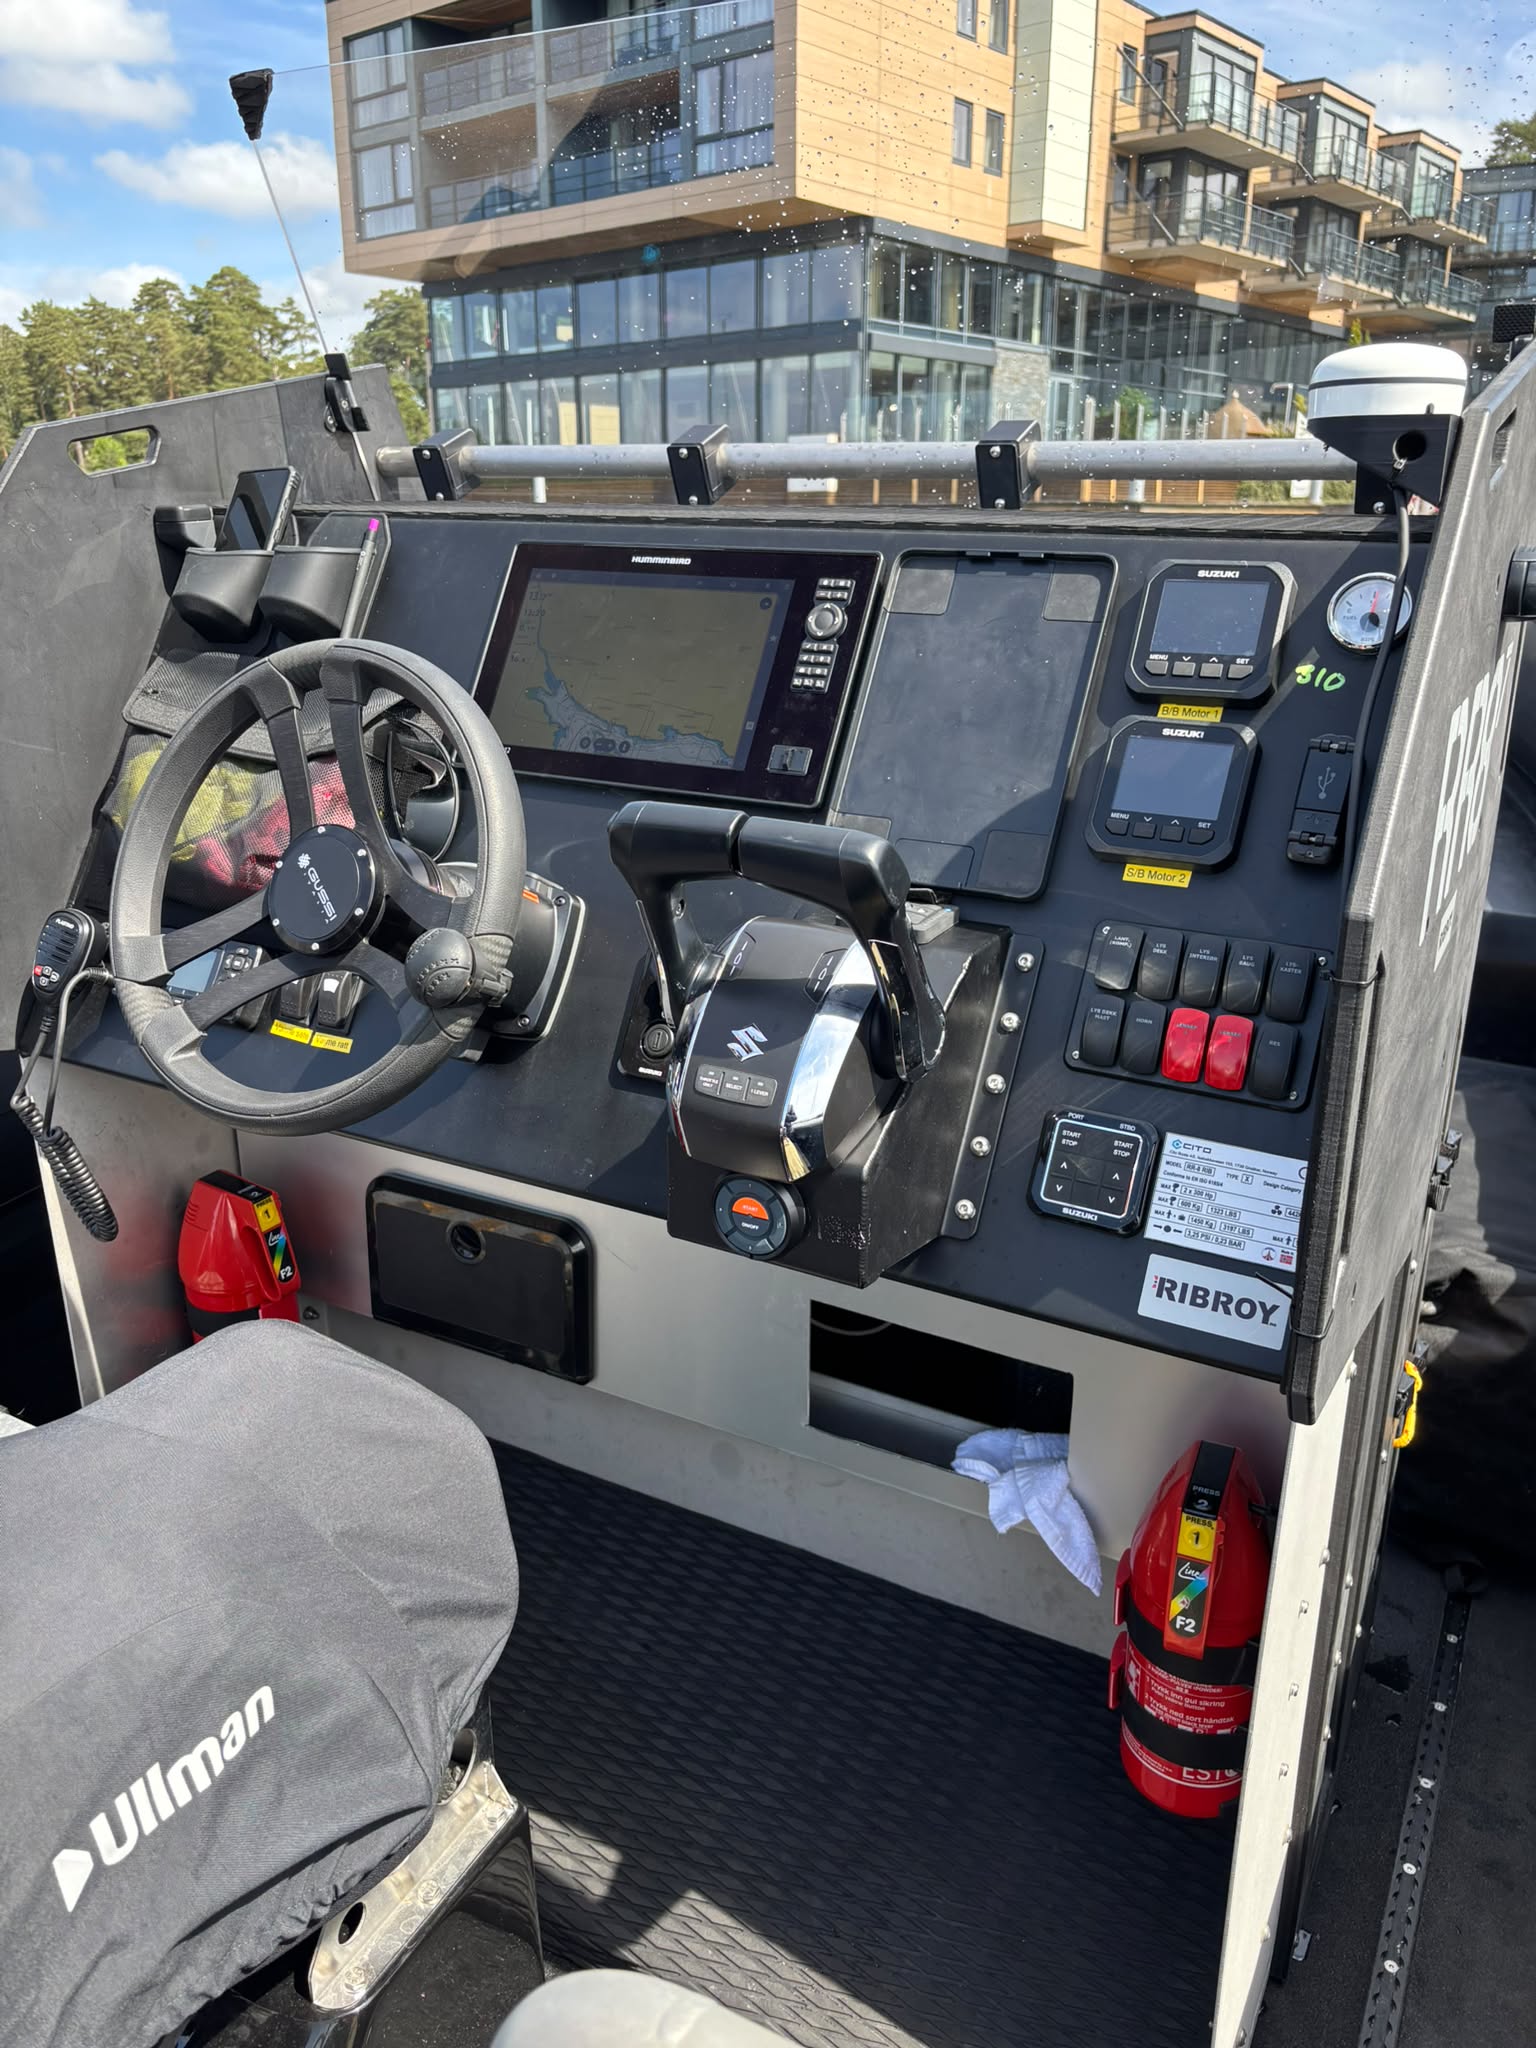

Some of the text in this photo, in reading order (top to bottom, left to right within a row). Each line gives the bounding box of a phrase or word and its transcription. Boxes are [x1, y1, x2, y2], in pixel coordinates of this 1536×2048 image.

[631, 555, 691, 565] HUMMINBIRD
[1197, 570, 1240, 578] SUZUKI
[1162, 706, 1219, 718] B/B Motor 1
[1162, 728, 1204, 739] SUZUKI
[1110, 812, 1130, 820] MENU
[1126, 867, 1186, 883] S/B Motor 2
[307, 867, 337, 921] GUSSI
[725, 1083, 743, 1091] SELECT
[754, 1089, 769, 1097] LEVER
[1068, 1112, 1085, 1120] PORT
[1062, 1130, 1082, 1138] START
[1113, 1140, 1134, 1149] START
[1183, 1144, 1212, 1154] CITO
[1113, 1149, 1131, 1157] STOP
[1165, 1160, 1183, 1169] MODEL
[1226, 1172, 1239, 1181] TYPE
[1160, 1182, 1171, 1190] MAX
[1205, 1192, 1214, 1201] Hp
[1263, 1180, 1302, 1195] Design Category
[1157, 1195, 1169, 1203] MAX
[1192, 1203, 1201, 1212] Kg
[263, 1209, 271, 1219] 1
[1062, 1207, 1098, 1221] SUZUKI
[1154, 1209, 1165, 1217] MAX
[1205, 1220, 1214, 1229] Kg
[1224, 1210, 1237, 1219] LBS
[1237, 1227, 1251, 1236] LBS
[1200, 1233, 1211, 1241] PSI
[1228, 1240, 1242, 1249] BAR
[1272, 1235, 1284, 1243] MAX
[280, 1266, 293, 1280] F2
[1155, 1277, 1280, 1325] RIBROY
[1192, 1485, 1221, 1497] PRESS
[1194, 1499, 1209, 1510] 2
[1185, 1515, 1213, 1527] PRESS
[1192, 1531, 1200, 1545] 1
[1175, 1616, 1196, 1633] F2
[1184, 1695, 1197, 1706] gul
[1199, 1699, 1225, 1709] sikring
[1169, 1707, 1184, 1720] ned
[1185, 1713, 1202, 1724] sort
[88, 1685, 275, 1865] Ullman
